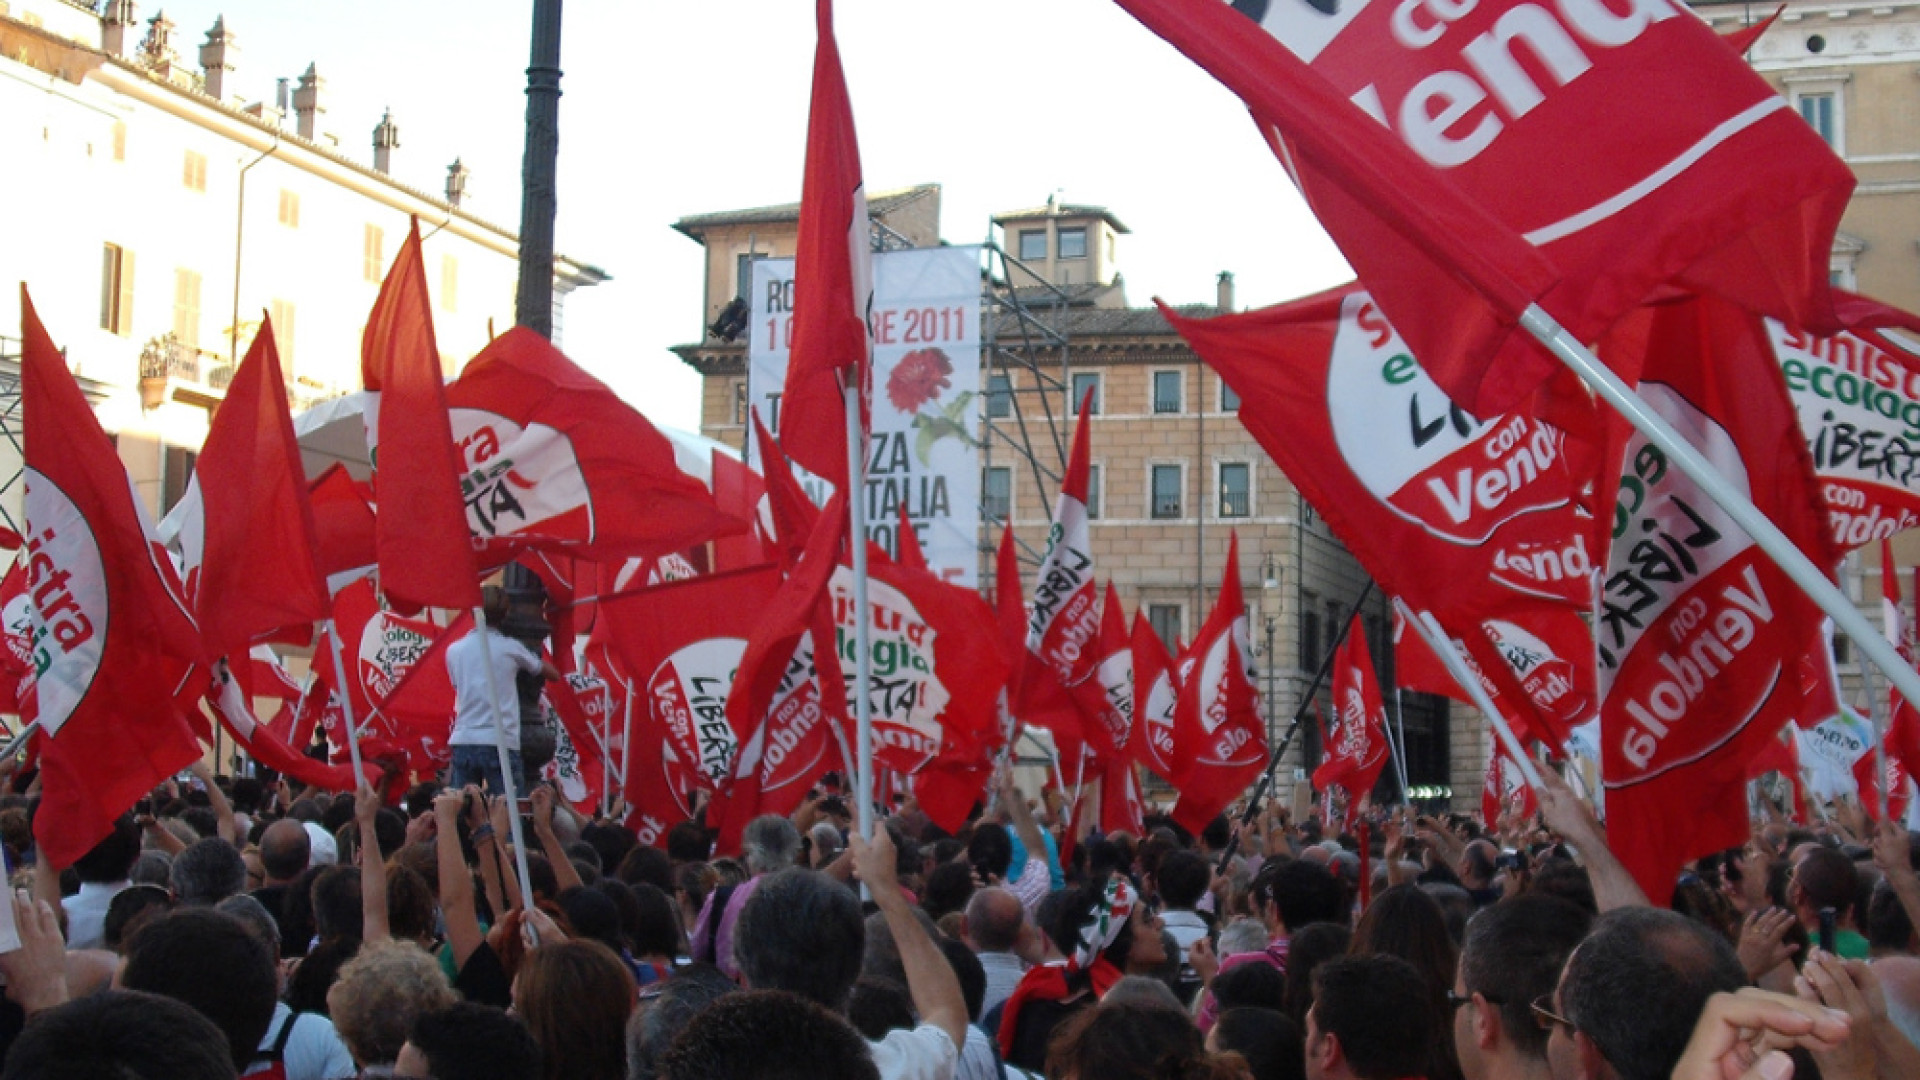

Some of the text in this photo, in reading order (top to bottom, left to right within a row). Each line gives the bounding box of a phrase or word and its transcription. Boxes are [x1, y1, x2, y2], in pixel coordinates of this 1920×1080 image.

[903, 306, 965, 344] 2011
[1485, 414, 1528, 460] con
[1824, 483, 1867, 510] con
